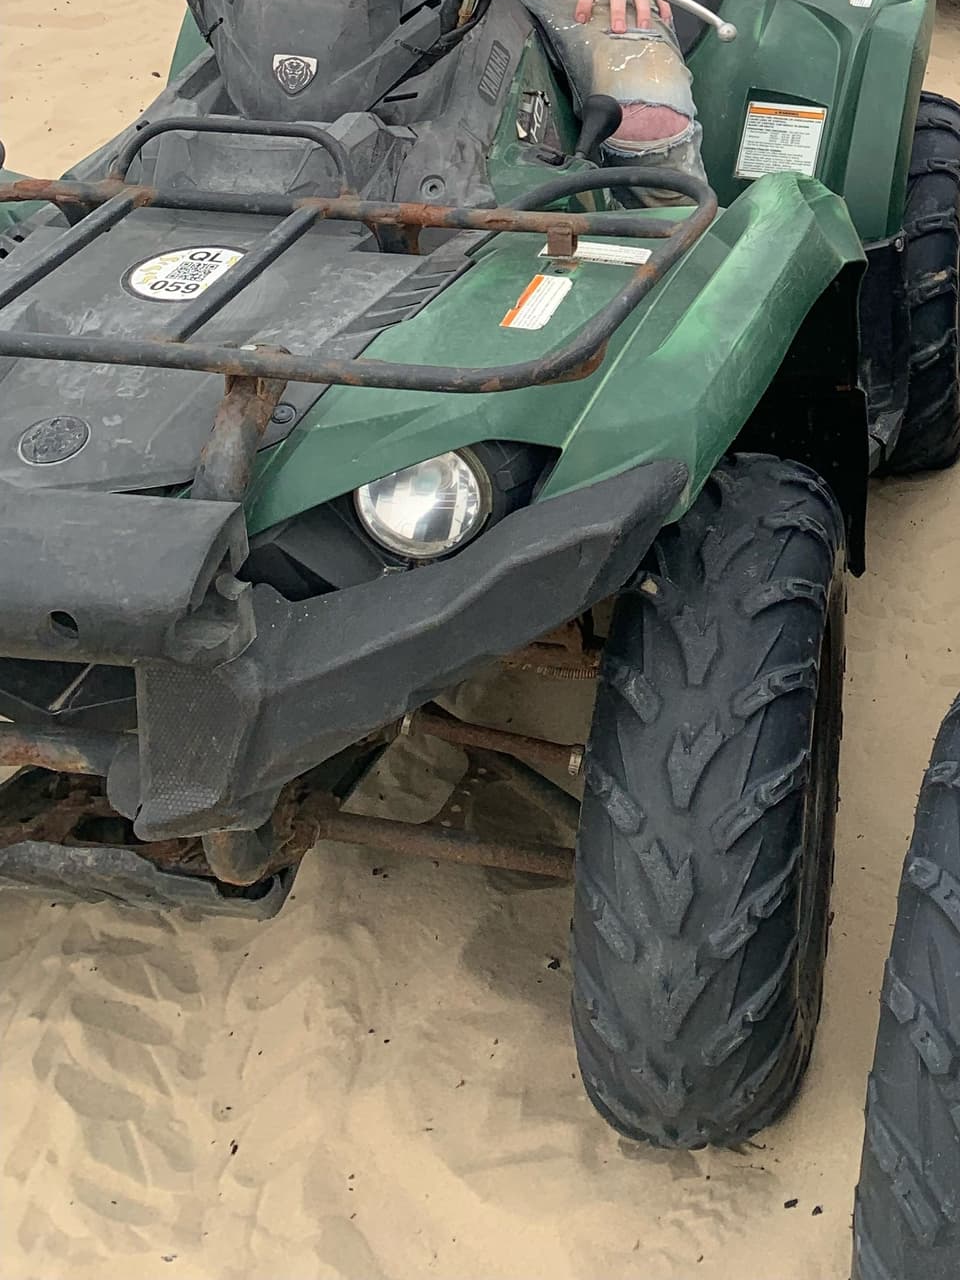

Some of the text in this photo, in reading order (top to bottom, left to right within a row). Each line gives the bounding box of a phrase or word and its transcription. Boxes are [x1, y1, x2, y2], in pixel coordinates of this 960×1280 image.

[479, 44, 510, 100] YAMAHA
[188, 250, 224, 263] QL
[149, 280, 201, 294] 059
